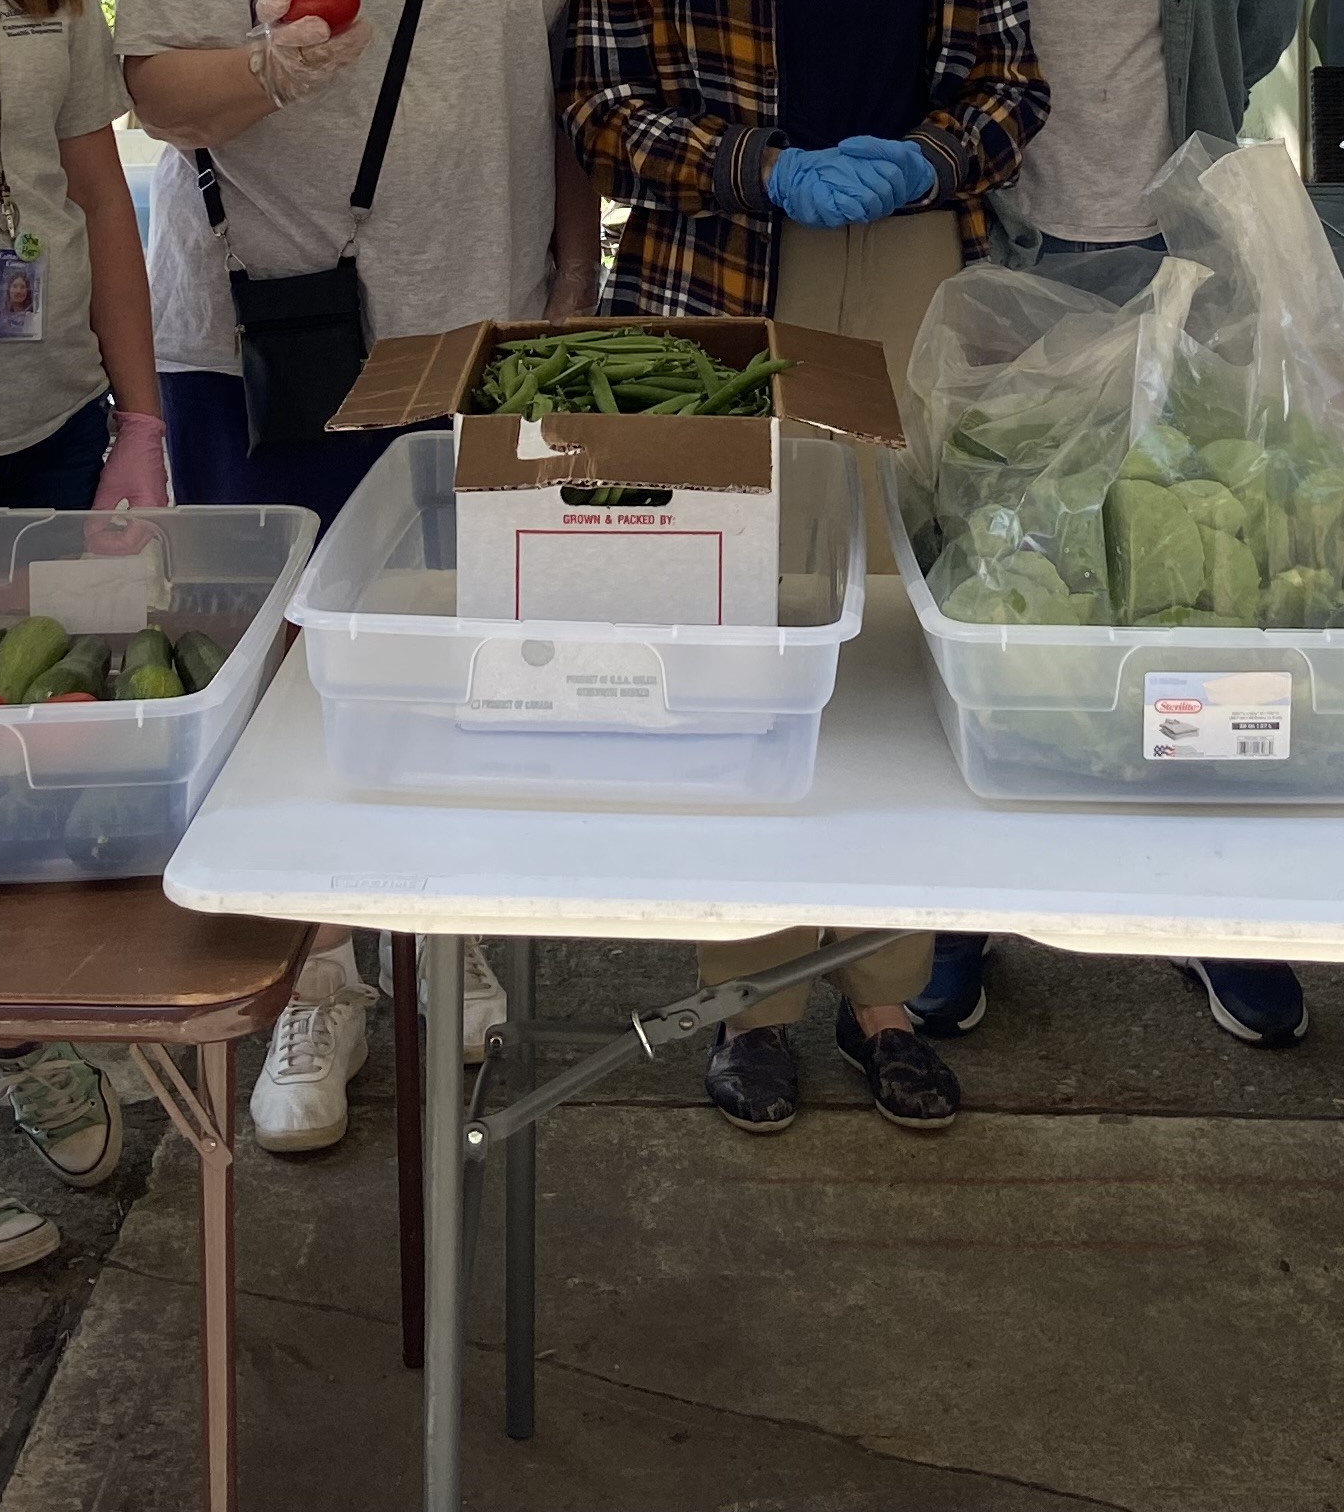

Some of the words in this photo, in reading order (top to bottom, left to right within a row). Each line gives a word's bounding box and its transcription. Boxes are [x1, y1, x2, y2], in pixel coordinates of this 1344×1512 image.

[562, 514, 601, 525] GROWN
[604, 514, 613, 525] &
[617, 514, 655, 525] PACKED
[1158, 699, 1198, 713] Sterilite
